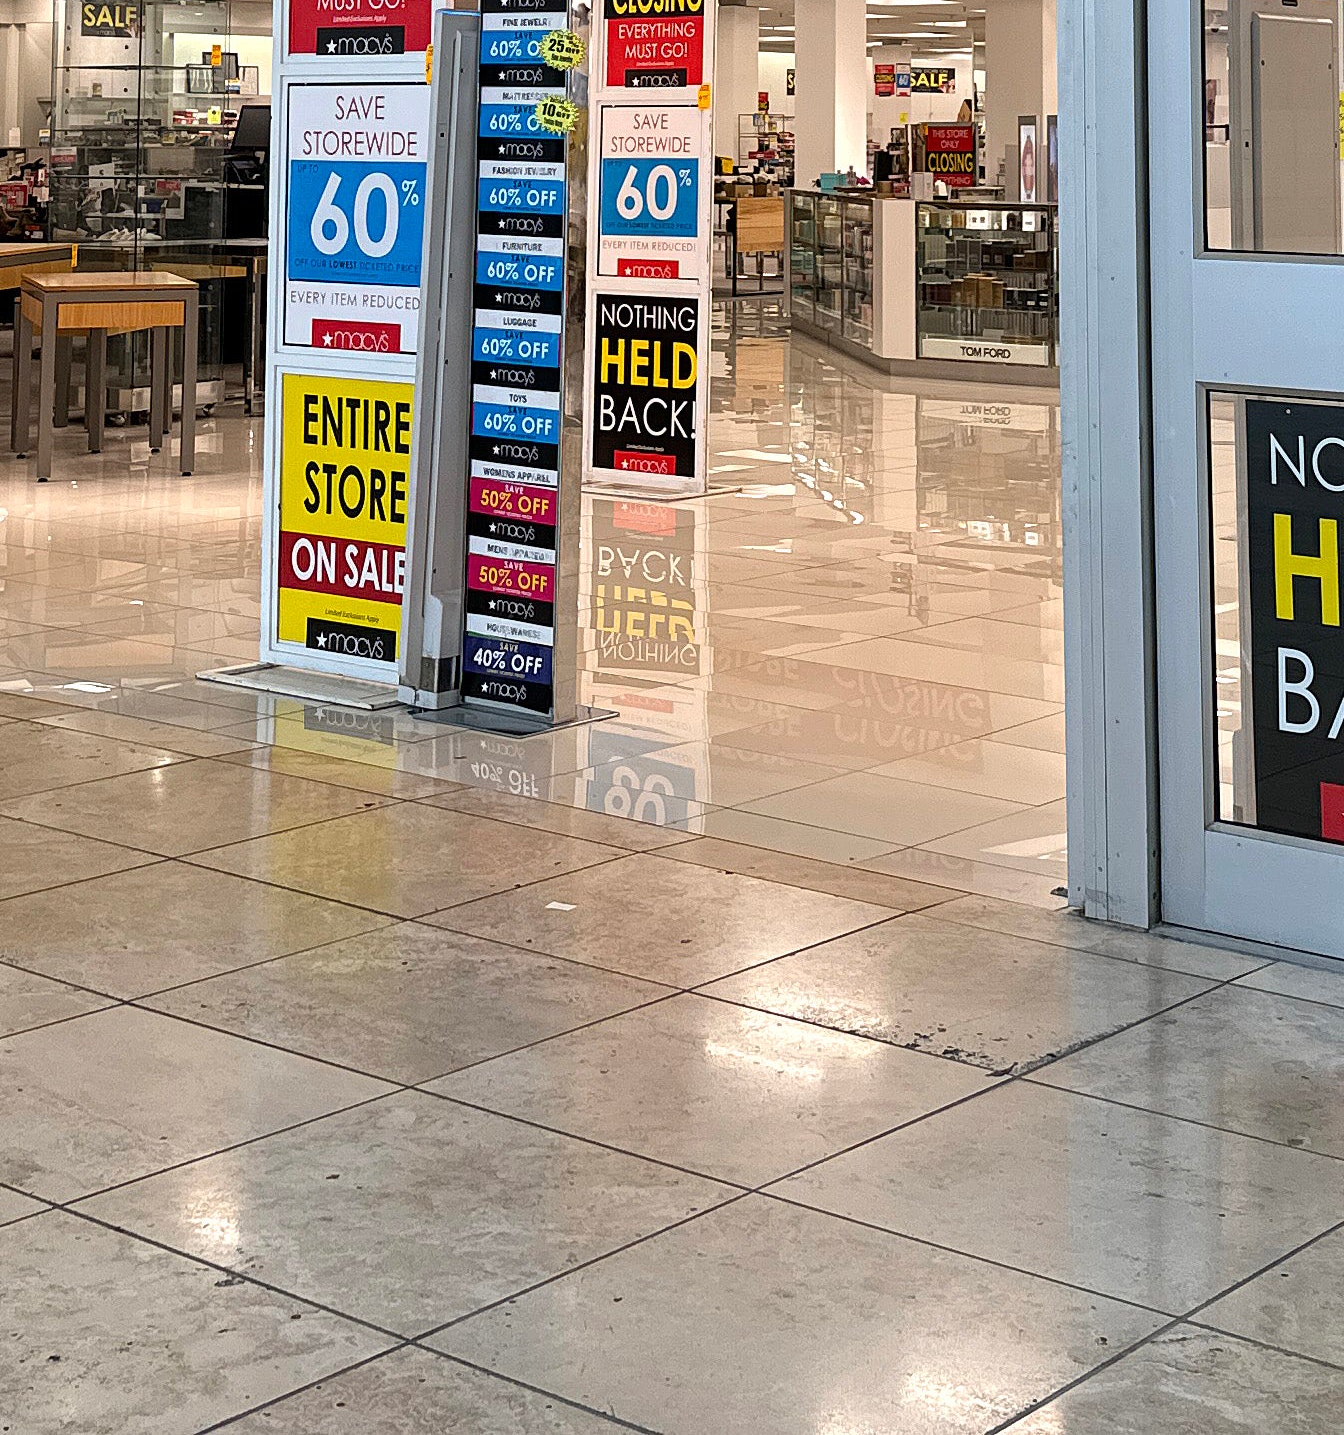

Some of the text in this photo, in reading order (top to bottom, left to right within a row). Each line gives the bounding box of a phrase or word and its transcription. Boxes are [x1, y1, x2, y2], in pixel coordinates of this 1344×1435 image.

[618, 22, 696, 39] EVERYTHING
[625, 42, 688, 58] MUST GO!
[335, 95, 385, 120] SAVE
[633, 114, 669, 130] SAVE
[303, 131, 418, 156] STOREWIDE
[932, 129, 969, 139] THIS STORE
[611, 136, 691, 153] STOREWIDE
[940, 140, 959, 149] ONLY
[928, 153, 973, 173] CLOSING
[489, 188, 557, 207] 60% OFF
[616, 164, 692, 220] 60%
[311, 172, 418, 258] 60%
[502, 242, 543, 251] FURNITURE
[602, 240, 627, 250] EVERY
[630, 241, 649, 250] ITEM
[487, 262, 555, 282] 60% OFF
[290, 290, 421, 310] EVERY ITEM REDUCED
[503, 317, 537, 327] LUGGAGE
[601, 303, 696, 331] NOTHING
[481, 339, 549, 359] 60% OFF
[960, 345, 1011, 359] TOM FORD
[600, 337, 698, 389] HELD
[509, 394, 527, 403] TOYS
[304, 394, 411, 455] ENTIRE
[484, 413, 553, 435] 60% OFF
[599, 394, 697, 439] BACK!
[304, 461, 406, 524] STORE
[505, 484, 524, 494] SAVE
[480, 489, 513, 511] 50%
[518, 496, 550, 515] OFF
[291, 538, 406, 594] ON SALE
[479, 566, 513, 587] 50%
[517, 572, 548, 593] OFF
[473, 648, 506, 670] 40%
[511, 654, 543, 675] OFF
